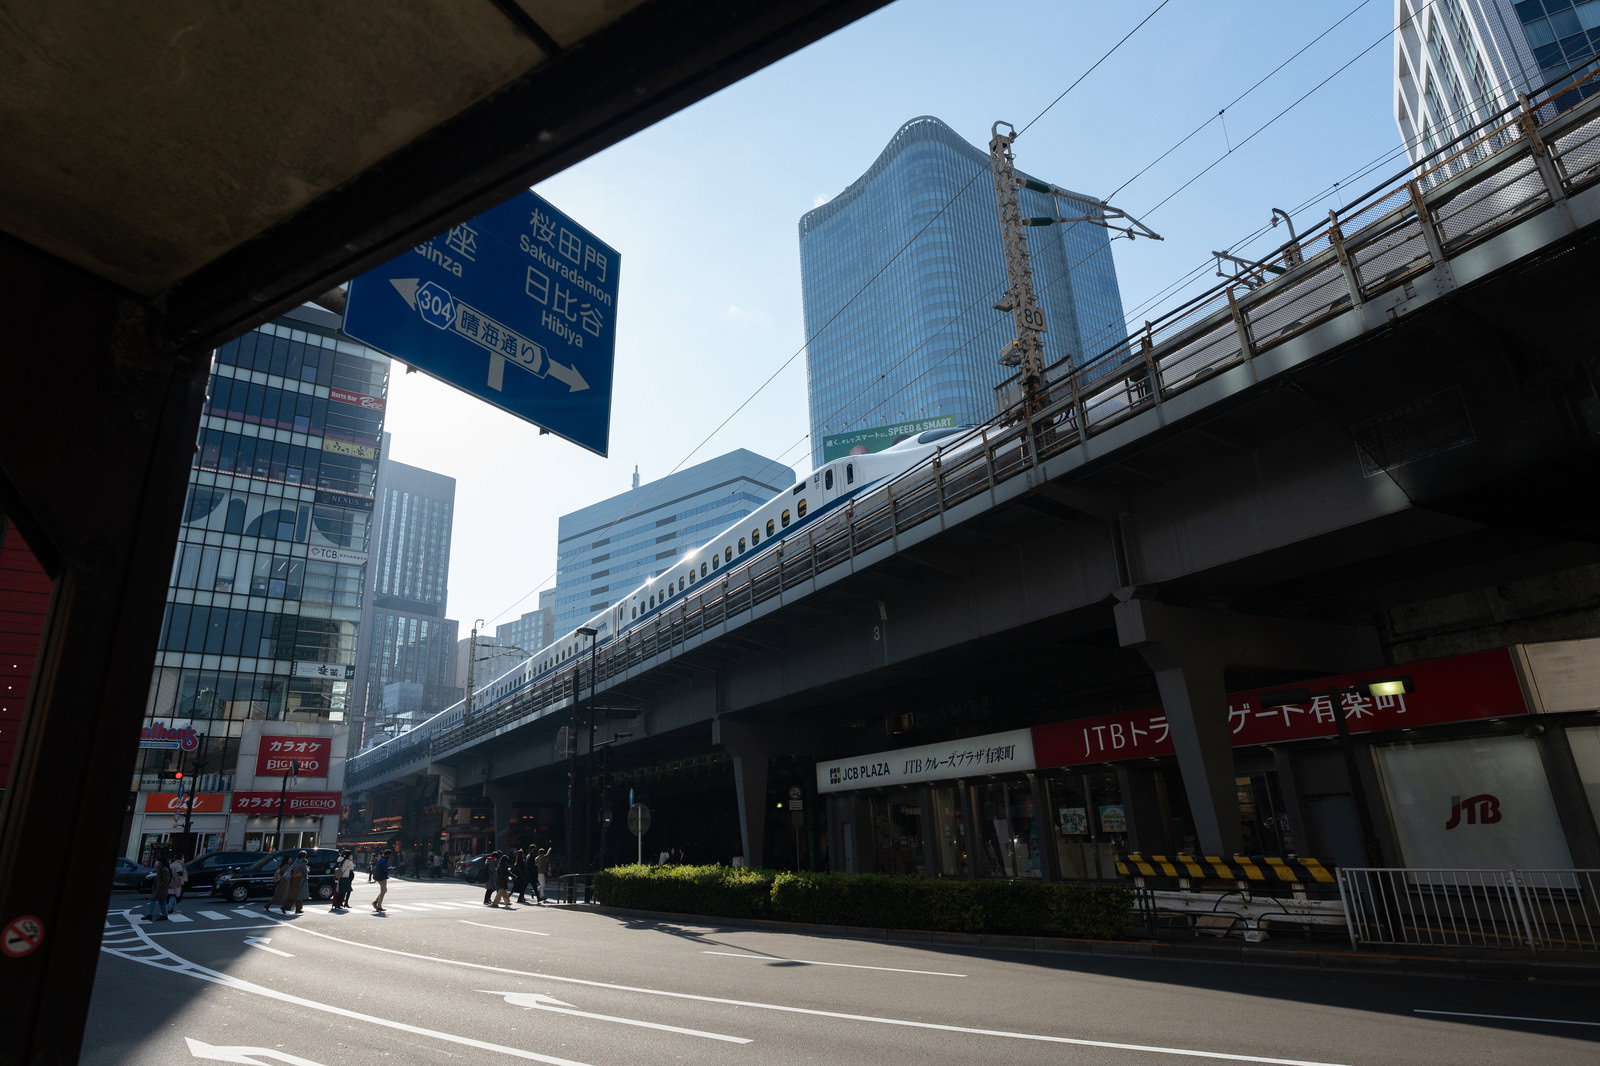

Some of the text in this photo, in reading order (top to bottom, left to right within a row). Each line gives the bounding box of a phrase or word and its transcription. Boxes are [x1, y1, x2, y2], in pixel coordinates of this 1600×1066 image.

[530, 208, 608, 283] 桜田門
[519, 234, 612, 307] Sakuradamon
[420, 290, 451, 322] 304
[525, 265, 604, 338] 日比谷
[541, 310, 584, 348] Hibiya
[1024, 308, 1043, 327] 80
[460, 311, 536, 365] 晴海通り
[359, 396, 384, 409] Bee
[888, 424, 915, 436] SPEED
[923, 417, 952, 431] SMART
[332, 495, 359, 505] NEXUS
[321, 548, 338, 559] TCB
[141, 722, 199, 751] athan's
[269, 741, 322, 753] カラオケ
[842, 762, 890, 781] JCB PLAZA
[309, 799, 337, 809] ECHO
[1446, 794, 1502, 831] JTB
